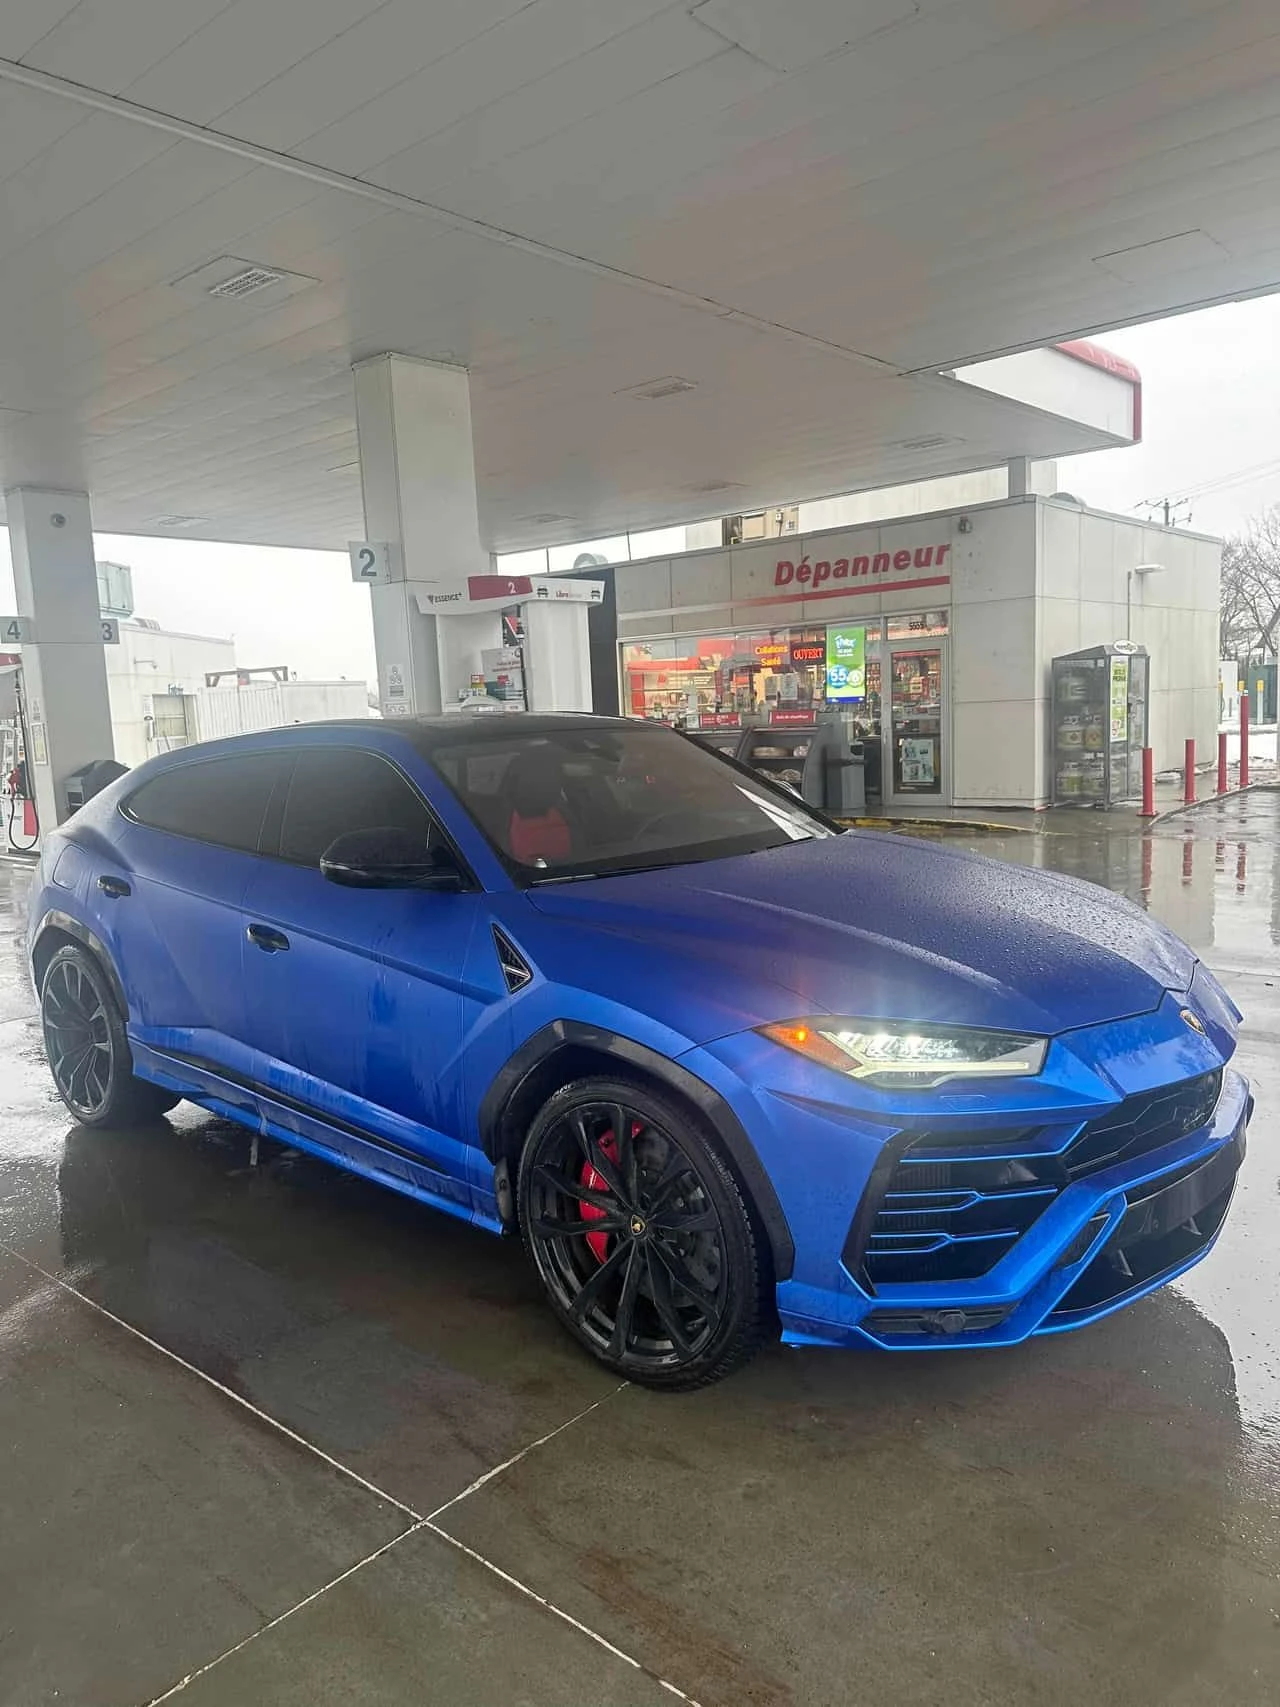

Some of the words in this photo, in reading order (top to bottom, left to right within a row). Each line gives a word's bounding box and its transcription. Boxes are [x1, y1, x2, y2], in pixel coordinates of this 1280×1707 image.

[358, 547, 377, 577] 2
[775, 543, 951, 588] Dépanneur
[507, 581, 516, 594] 2
[7, 619, 21, 640] 4
[101, 621, 113, 641] 3
[793, 647, 824, 660] OUVERT
